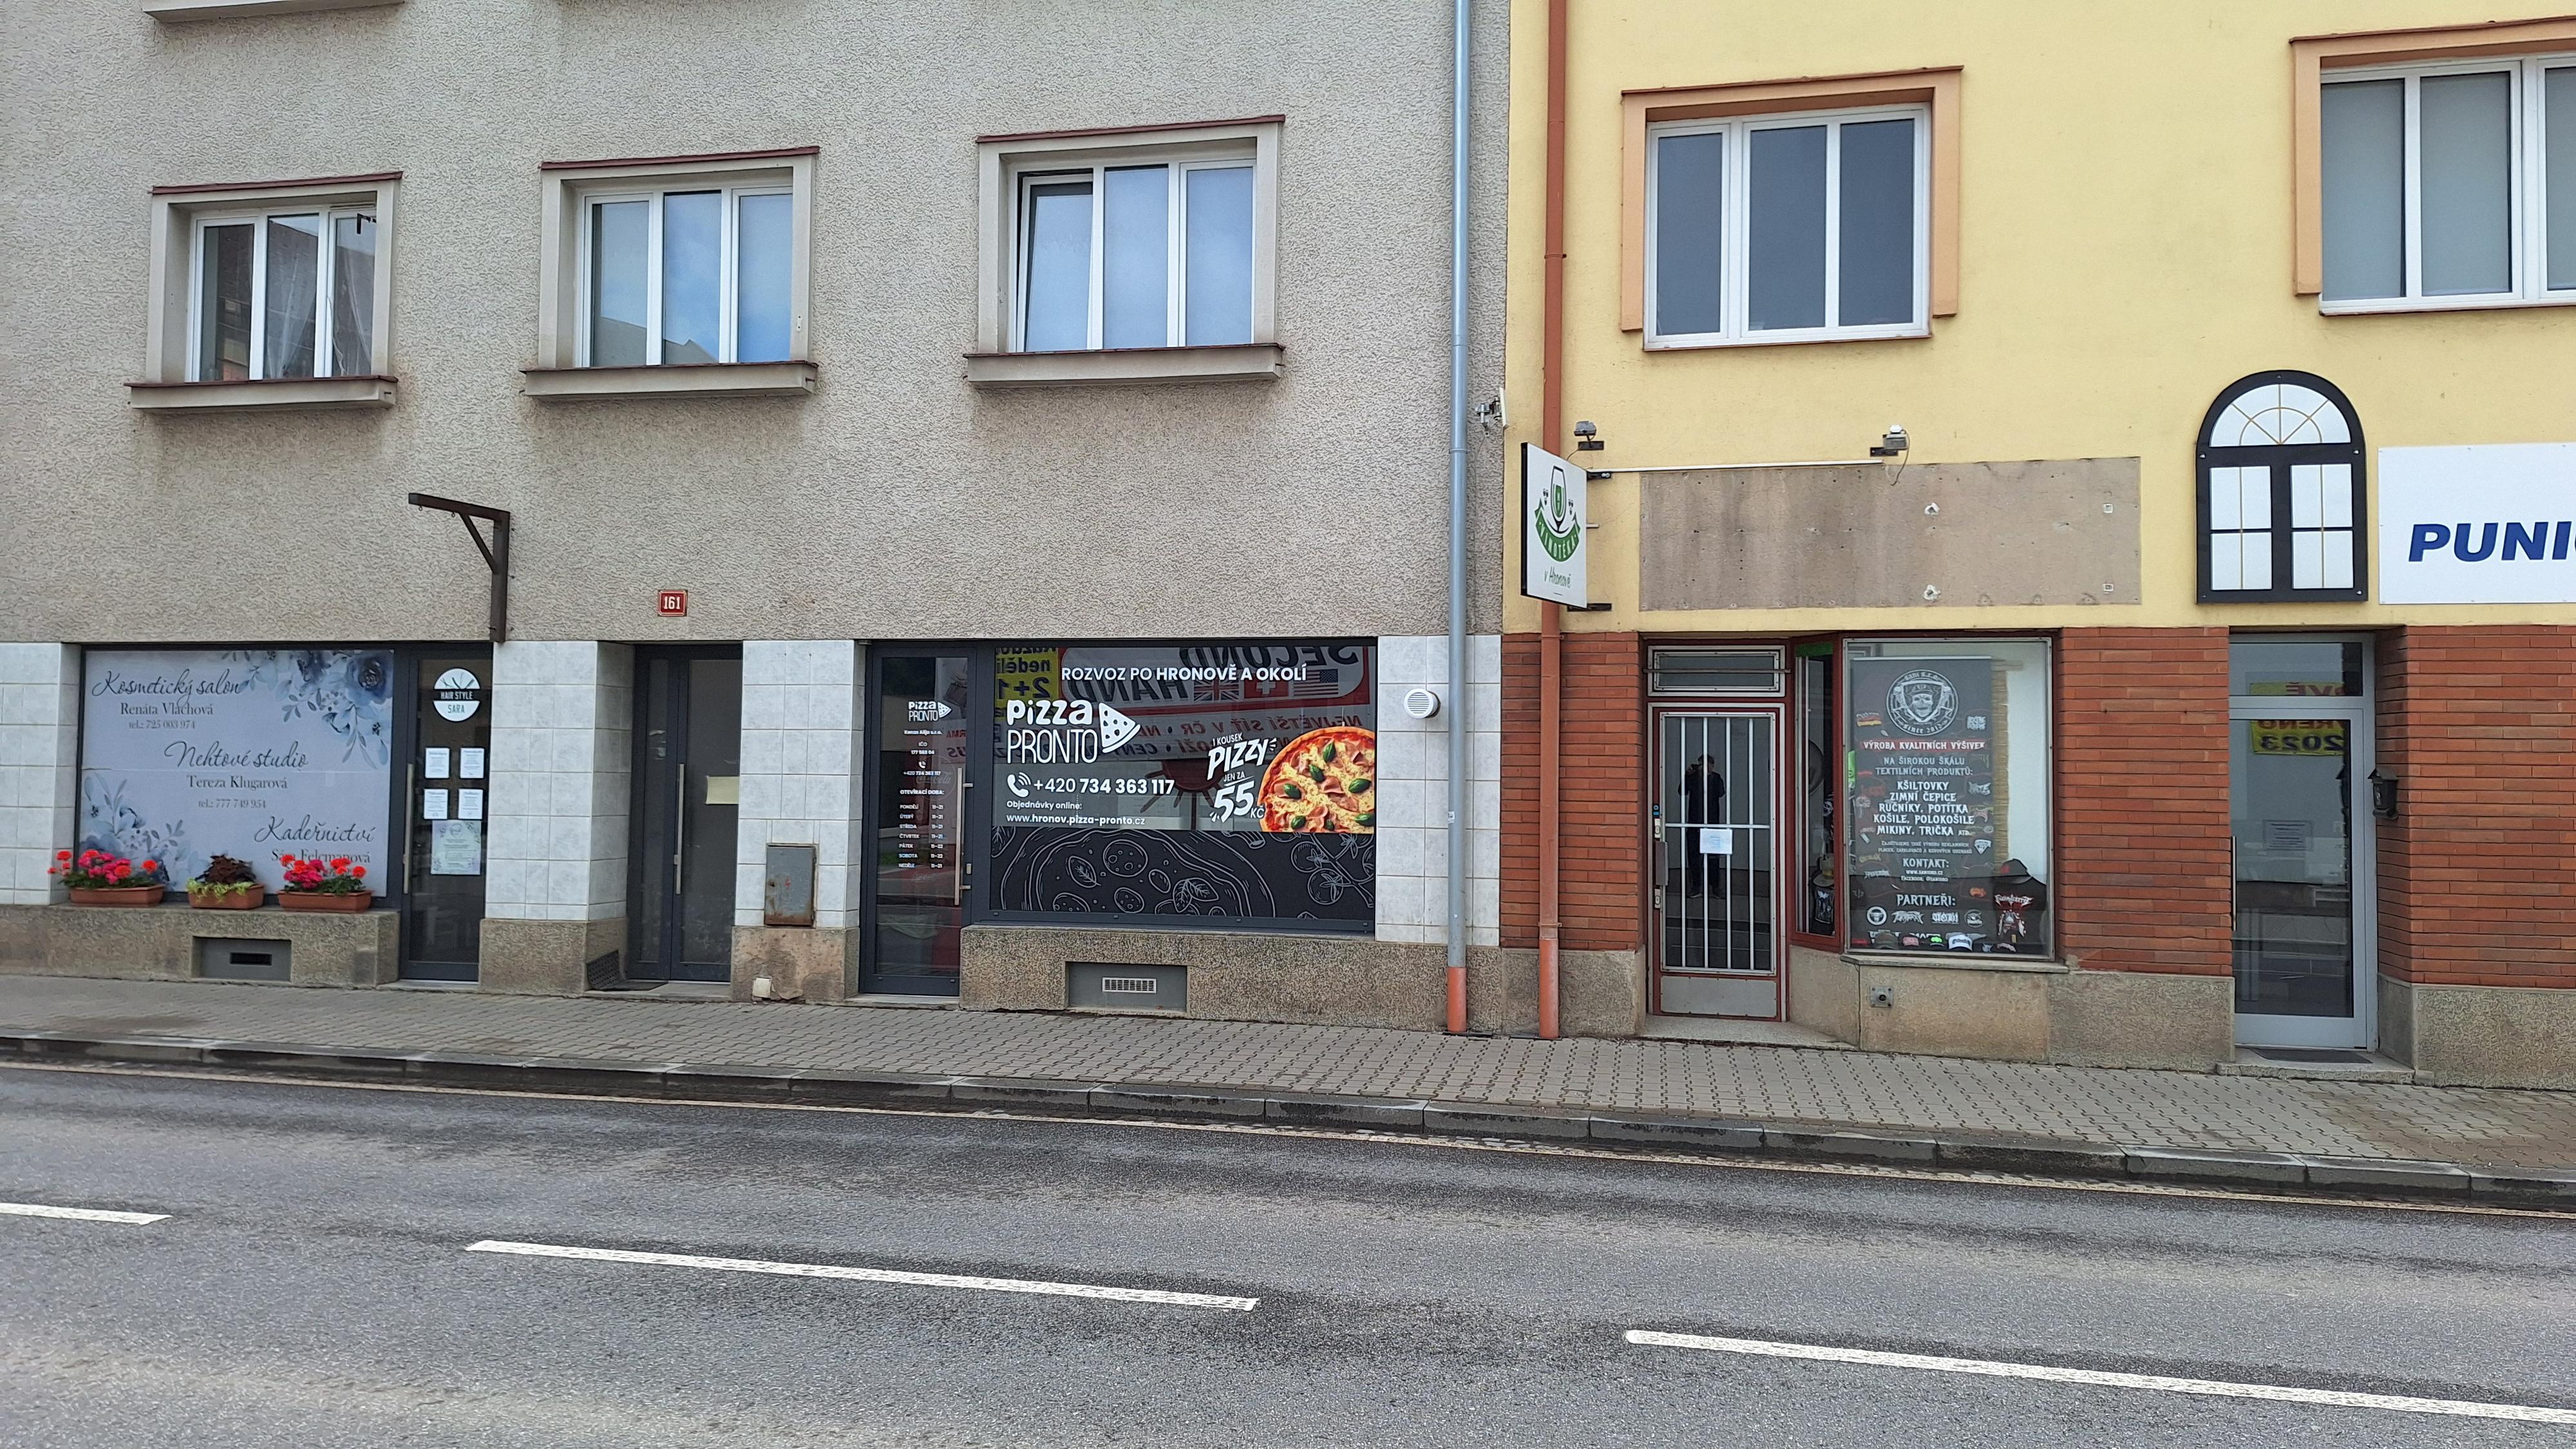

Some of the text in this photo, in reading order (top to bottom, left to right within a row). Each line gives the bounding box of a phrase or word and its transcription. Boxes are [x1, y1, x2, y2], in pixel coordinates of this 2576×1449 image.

[1540, 524, 1577, 560] VINOTÉKA
[2408, 520, 2576, 563] PUNI
[663, 596, 681, 610] 161
[1061, 663, 1307, 681] ROZVOZ PO HRONOVĚ A OKOLÍ
[91, 668, 241, 706] Kosmetický salon
[440, 690, 473, 700] HAIR STYLE
[120, 702, 158, 715] Renáta
[909, 710, 938, 722] PRONTO
[1212, 732, 1244, 746] 1 KOUSEK
[1863, 740, 1986, 750] VÝROBA KVALITNÍCH VÝŠIVEK
[1007, 729, 1098, 764] PRONTO
[164, 741, 309, 768] Nehtové studio
[1207, 738, 1269, 781] PIZZY
[1899, 756, 1935, 765] ŠIROKOU
[1938, 755, 1965, 764] ŠKÁLU
[1224, 771, 1245, 782] JEN ZA
[1875, 766, 1973, 776] TEXTILNÍCH PRODUKTŮ:
[186, 775, 288, 791] Tereza Klugarová
[1034, 778, 1175, 794] +420 734 363 117
[1897, 780, 1949, 791] KŠILTOVKY
[1213, 780, 1255, 823] 55
[1889, 791, 1957, 802] ZIMNÍ ČEPICE
[216, 799, 231, 808] 777
[1007, 800, 1083, 811] Objednávky online:
[1928, 802, 1969, 814] POTÍTKA
[1007, 813, 1146, 826] www.hronov.pizza-pronto.cz
[1915, 813, 1975, 825] POLOKOŠILE
[254, 814, 376, 843] Kadeřnictví
[1919, 825, 1954, 837] TRIČKA
[1902, 858, 1950, 869] KONTAKT:
[1897, 893, 1956, 907] PARTNEŘI:
